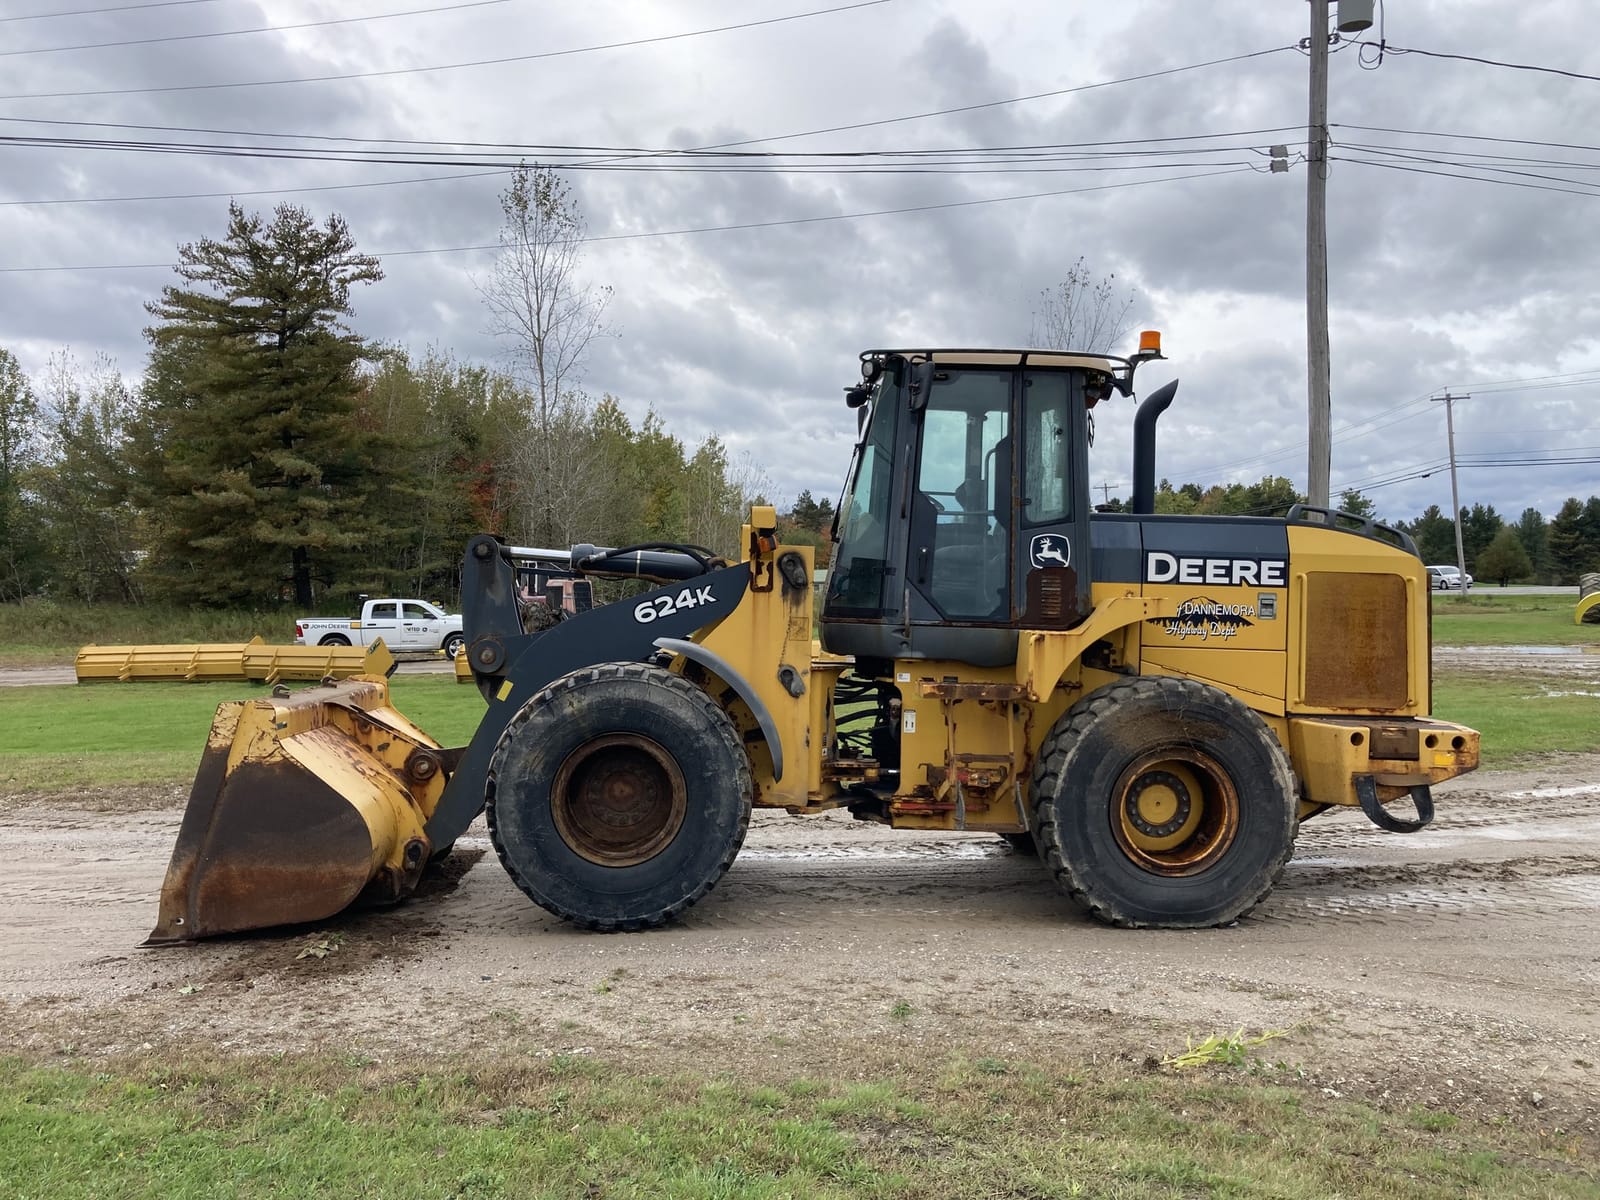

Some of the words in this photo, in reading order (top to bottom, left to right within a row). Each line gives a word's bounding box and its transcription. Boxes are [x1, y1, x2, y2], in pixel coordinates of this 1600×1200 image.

[1147, 552, 1285, 586] DEERE
[634, 584, 717, 623] 624K
[1185, 602, 1256, 616] DANNEMORA
[1165, 620, 1208, 640] Highway
